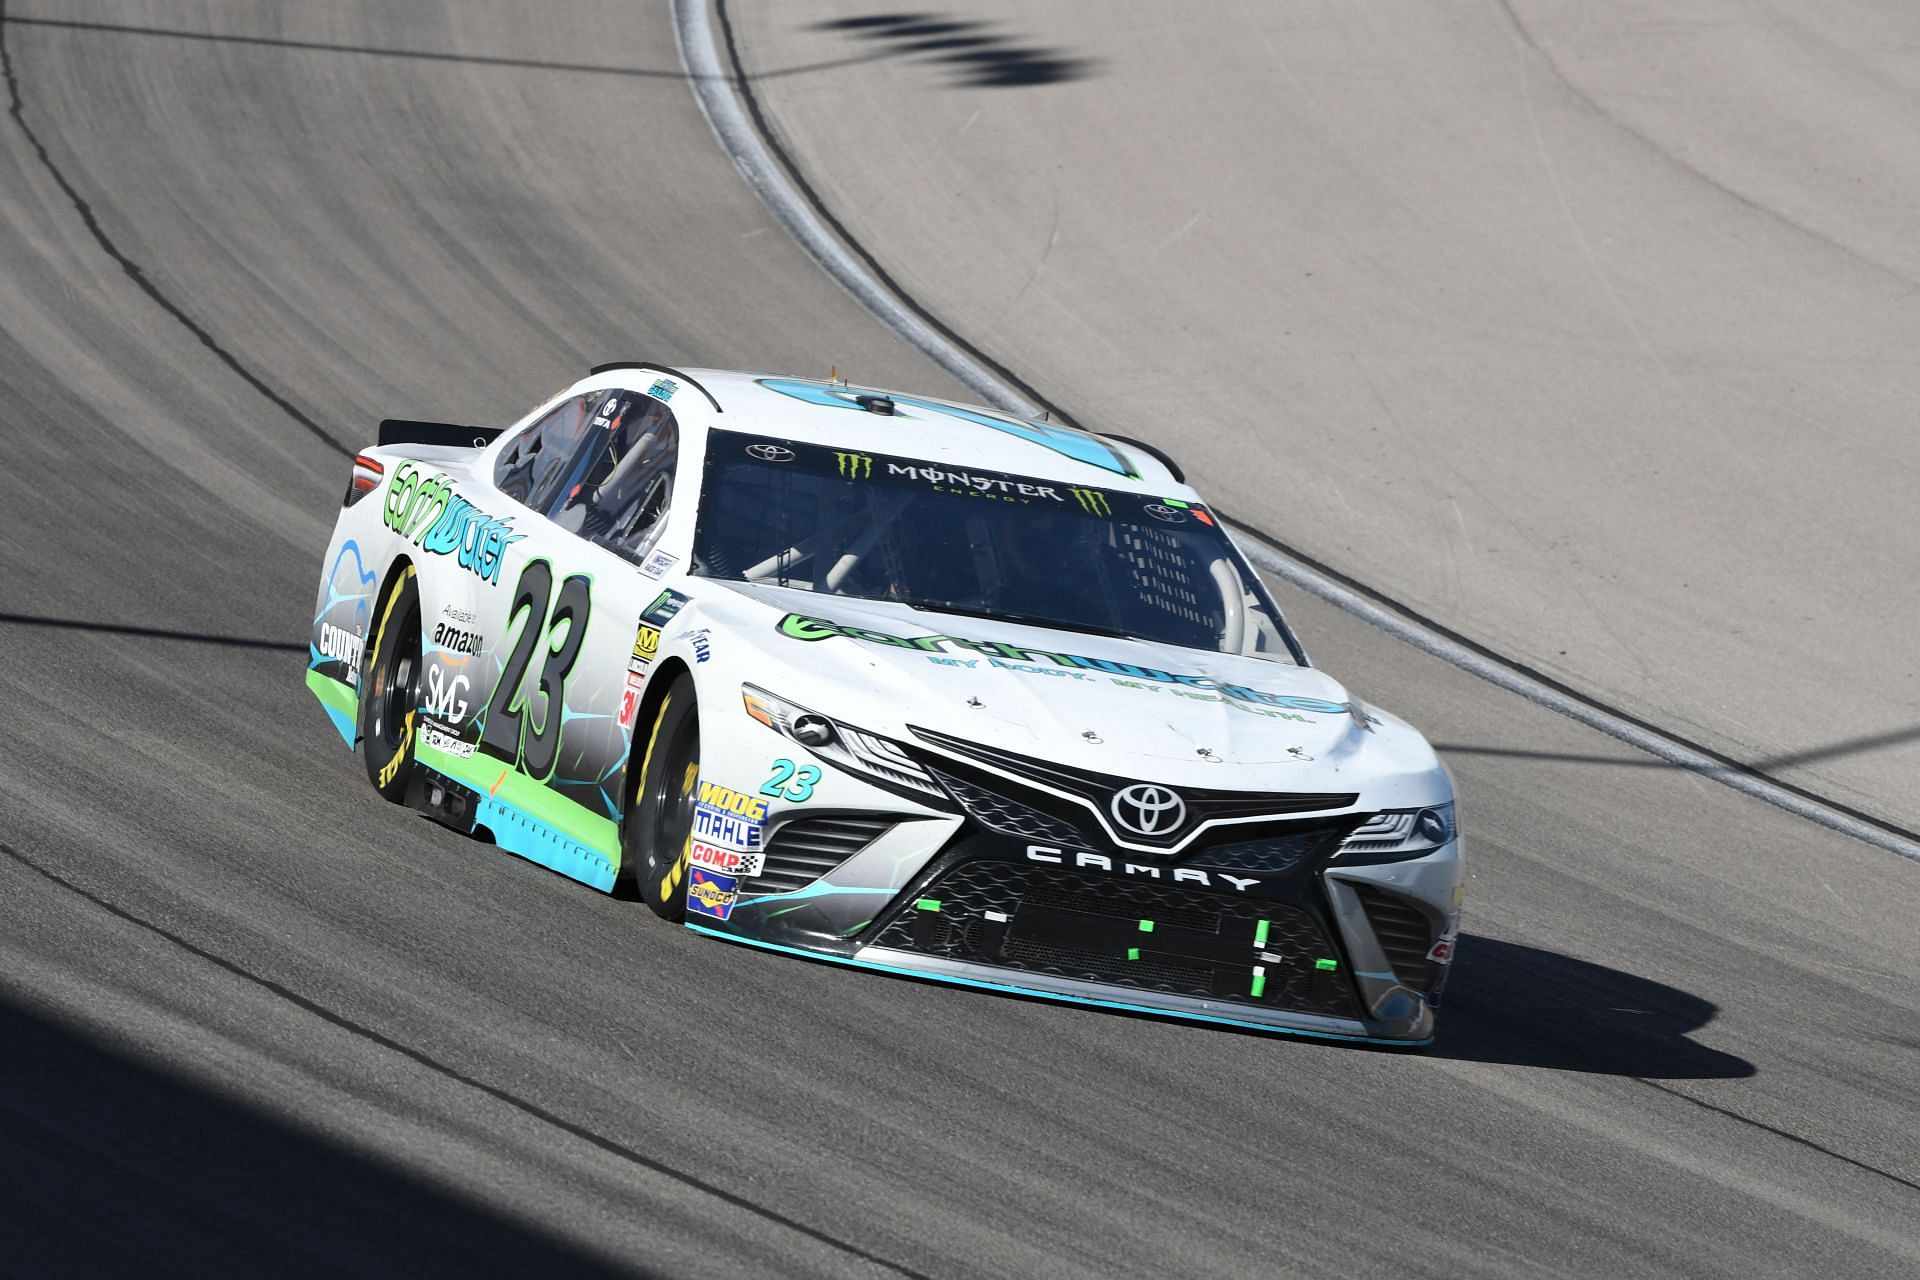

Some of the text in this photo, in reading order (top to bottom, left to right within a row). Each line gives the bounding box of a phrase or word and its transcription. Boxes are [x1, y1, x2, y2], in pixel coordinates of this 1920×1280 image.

[887, 463, 1065, 501] MONSTER
[933, 485, 1030, 504] ENERGY
[434, 623, 483, 657] amazon
[476, 556, 596, 785] 23
[927, 656, 979, 669] MY
[1110, 678, 1162, 693] MY
[425, 663, 470, 724] SMG
[759, 758, 822, 803] 23
[700, 781, 768, 821] MOOG
[695, 810, 761, 847] MAHLE
[692, 844, 741, 867] COMP
[721, 865, 752, 874] CAMS
[1027, 845, 1262, 891] CAMRY
[691, 885, 732, 904] SUNOCO
